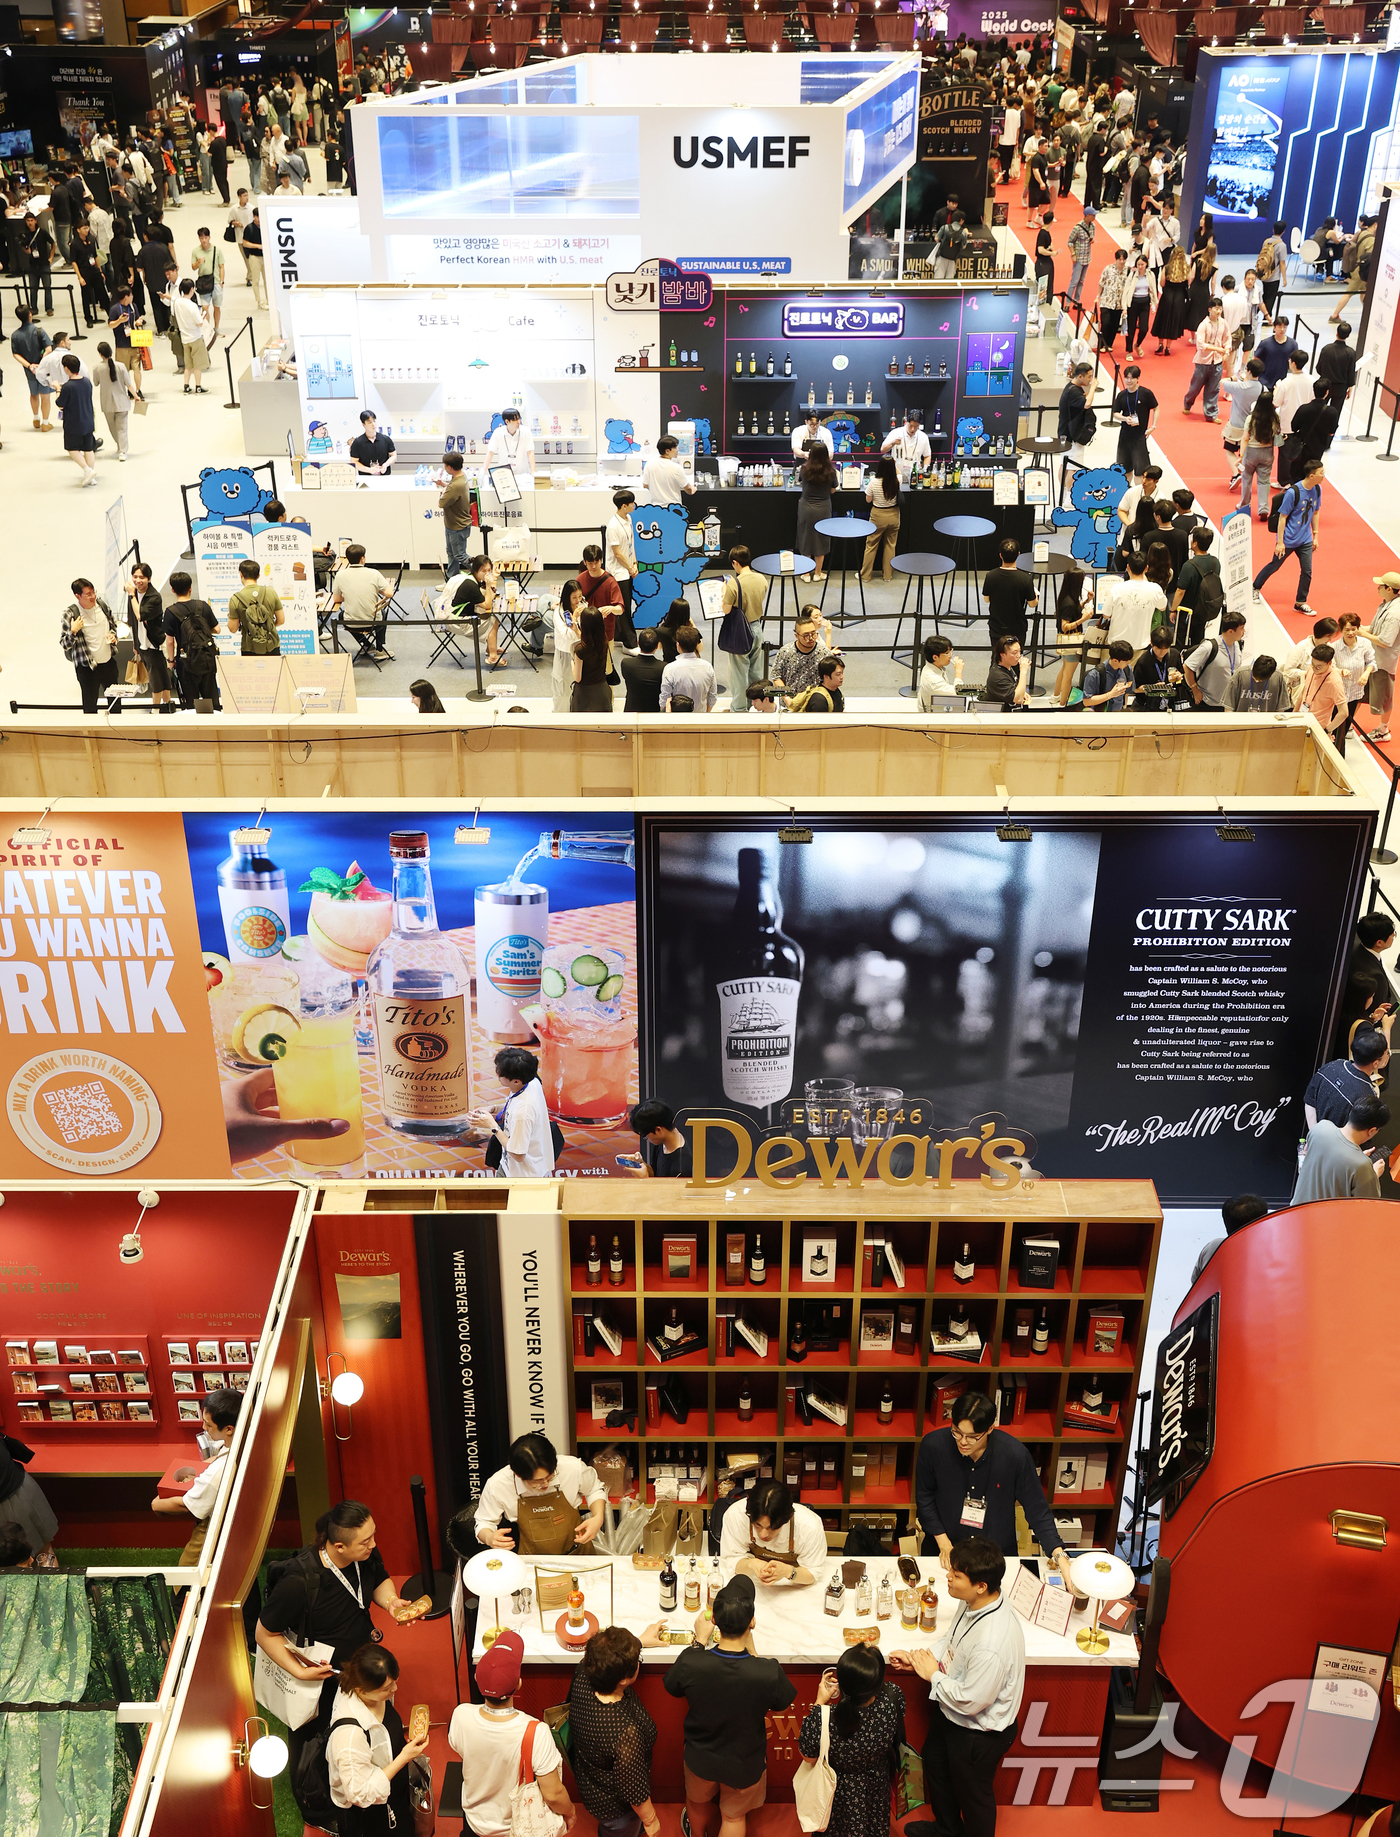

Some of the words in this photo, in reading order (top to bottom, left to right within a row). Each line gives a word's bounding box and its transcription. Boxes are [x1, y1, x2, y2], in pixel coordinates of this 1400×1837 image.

[981, 11, 1008, 19] 2025
[981, 20, 1017, 32] World
[66, 97, 90, 106] Thank
[92, 97, 105, 106] You
[920, 90, 980, 118] BOTTLE
[950, 119, 982, 127] BLENDED
[923, 126, 950, 134] SCOTCH
[954, 126, 982, 134] WHISKY
[673, 135, 810, 169] USMEF
[433, 238, 461, 250] 맛있고
[463, 238, 500, 250] 영양많은
[533, 238, 561, 249] 소고기
[563, 239, 571, 248] &
[572, 237, 610, 250] 돼지고기
[276, 217, 299, 289] USME
[440, 255, 475, 265] Perfect
[477, 255, 511, 265] Korean
[513, 255, 535, 265] HMR
[537, 255, 557, 265] with
[559, 255, 577, 265] U.S.
[579, 256, 604, 265] meat
[681, 261, 741, 270] SUSTAINABLE
[742, 261, 761, 271] U.S.
[761, 261, 787, 270] MEAT
[640, 266, 679, 278] 진로토닉
[418, 314, 461, 327] 진로토닉
[508, 315, 535, 327] Cafe
[872, 312, 898, 324] BAR
[267, 534, 298, 542] 럭키드로우
[220, 541, 240, 549] 이벤트
[281, 543, 300, 551] 리스트
[1240, 689, 1273, 700] Hustle
[73, 855, 102, 866] OF
[0, 870, 166, 914] ATEVER
[1135, 908, 1222, 930] CUTTY
[25, 918, 174, 957] WANNA
[510, 938, 528, 946] Tito's
[1132, 937, 1228, 947] PROHIBITION
[1231, 937, 1292, 947] EDITION
[503, 950, 536, 959] Sam's
[495, 958, 542, 967] Summer
[1128, 964, 1143, 972] has
[1143, 964, 1163, 972] been
[1163, 964, 1190, 972] crafted
[1205, 964, 1229, 973] salute
[1238, 965, 1251, 973] the
[1251, 965, 1288, 973] notorious
[502, 967, 537, 977] Spritz
[722, 981, 765, 997] CUTTY
[1123, 989, 1159, 999] smuggled
[1159, 989, 1181, 998] Cutty
[1181, 989, 1201, 997] Sark
[1200, 989, 1231, 997] blended
[1231, 989, 1257, 998] Scotch
[1257, 990, 1286, 999] whisky
[0, 960, 187, 1034] RINK
[385, 1004, 455, 1027] Tito's
[731, 1037, 788, 1050] PROHIBITION
[60, 1054, 107, 1070] WORTH
[22, 1057, 59, 1083] DRINK
[384, 1062, 465, 1081] Handmade
[17, 1082, 32, 1092] A
[108, 1064, 149, 1102] NAMING
[402, 1083, 447, 1092] VODKA
[13, 1091, 28, 1112] MIX
[394, 1101, 418, 1109] AUSTIN
[864, 1109, 923, 1125] 1846
[1138, 1107, 1200, 1144] Real
[45, 1149, 75, 1165] SCAN.
[119, 1141, 144, 1161] ENJOY.
[581, 1167, 609, 1175] with
[339, 1250, 391, 1262] Dewar's
[452, 1250, 468, 1314] WHEREVER
[522, 1250, 539, 1302] YOU'LL
[15, 1283, 35, 1293] THE
[41, 1282, 80, 1293] STORY
[457, 1316, 471, 1341] YOU
[525, 1307, 541, 1356] NEVER
[459, 1343, 472, 1365] GO,
[461, 1368, 474, 1387] GO
[527, 1361, 544, 1409] KNOW
[1187, 1382, 1196, 1407] 1846
[462, 1389, 476, 1417] WITH
[530, 1413, 545, 1424] IF
[465, 1419, 478, 1439] ALL
[466, 1440, 480, 1470] YOUR
[1323, 1660, 1340, 1669] 구매
[1341, 1663, 1367, 1674] 리워드
[1369, 1668, 1378, 1676] 존
